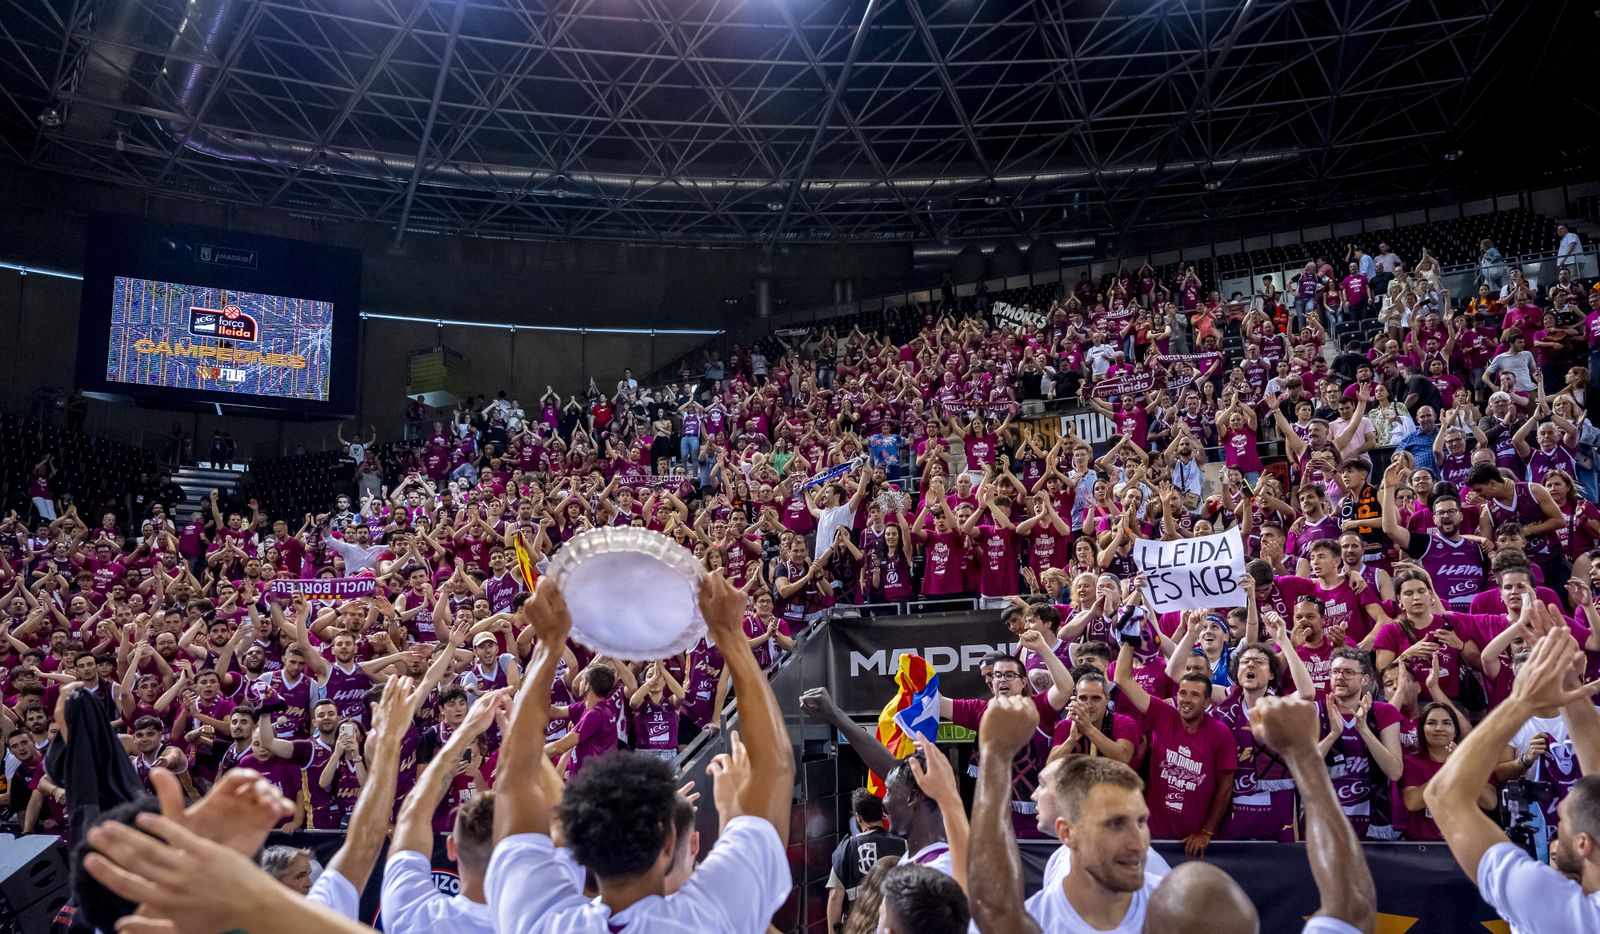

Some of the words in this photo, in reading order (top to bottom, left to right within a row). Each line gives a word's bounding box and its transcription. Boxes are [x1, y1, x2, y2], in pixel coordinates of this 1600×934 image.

[218, 326, 250, 338] lleida
[134, 339, 307, 369] CAMPEONES
[220, 368, 246, 382] FOUR
[1167, 376, 1191, 388] eida
[1141, 536, 1233, 571] LLEIDA
[336, 580, 376, 592] NUCLI
[1146, 570, 1182, 605] ÉS
[1189, 565, 1237, 597] ACB
[850, 643, 1018, 677] MADR
[653, 714, 664, 722] 24
[1337, 781, 1366, 799] CG
[431, 874, 460, 894] IZO
